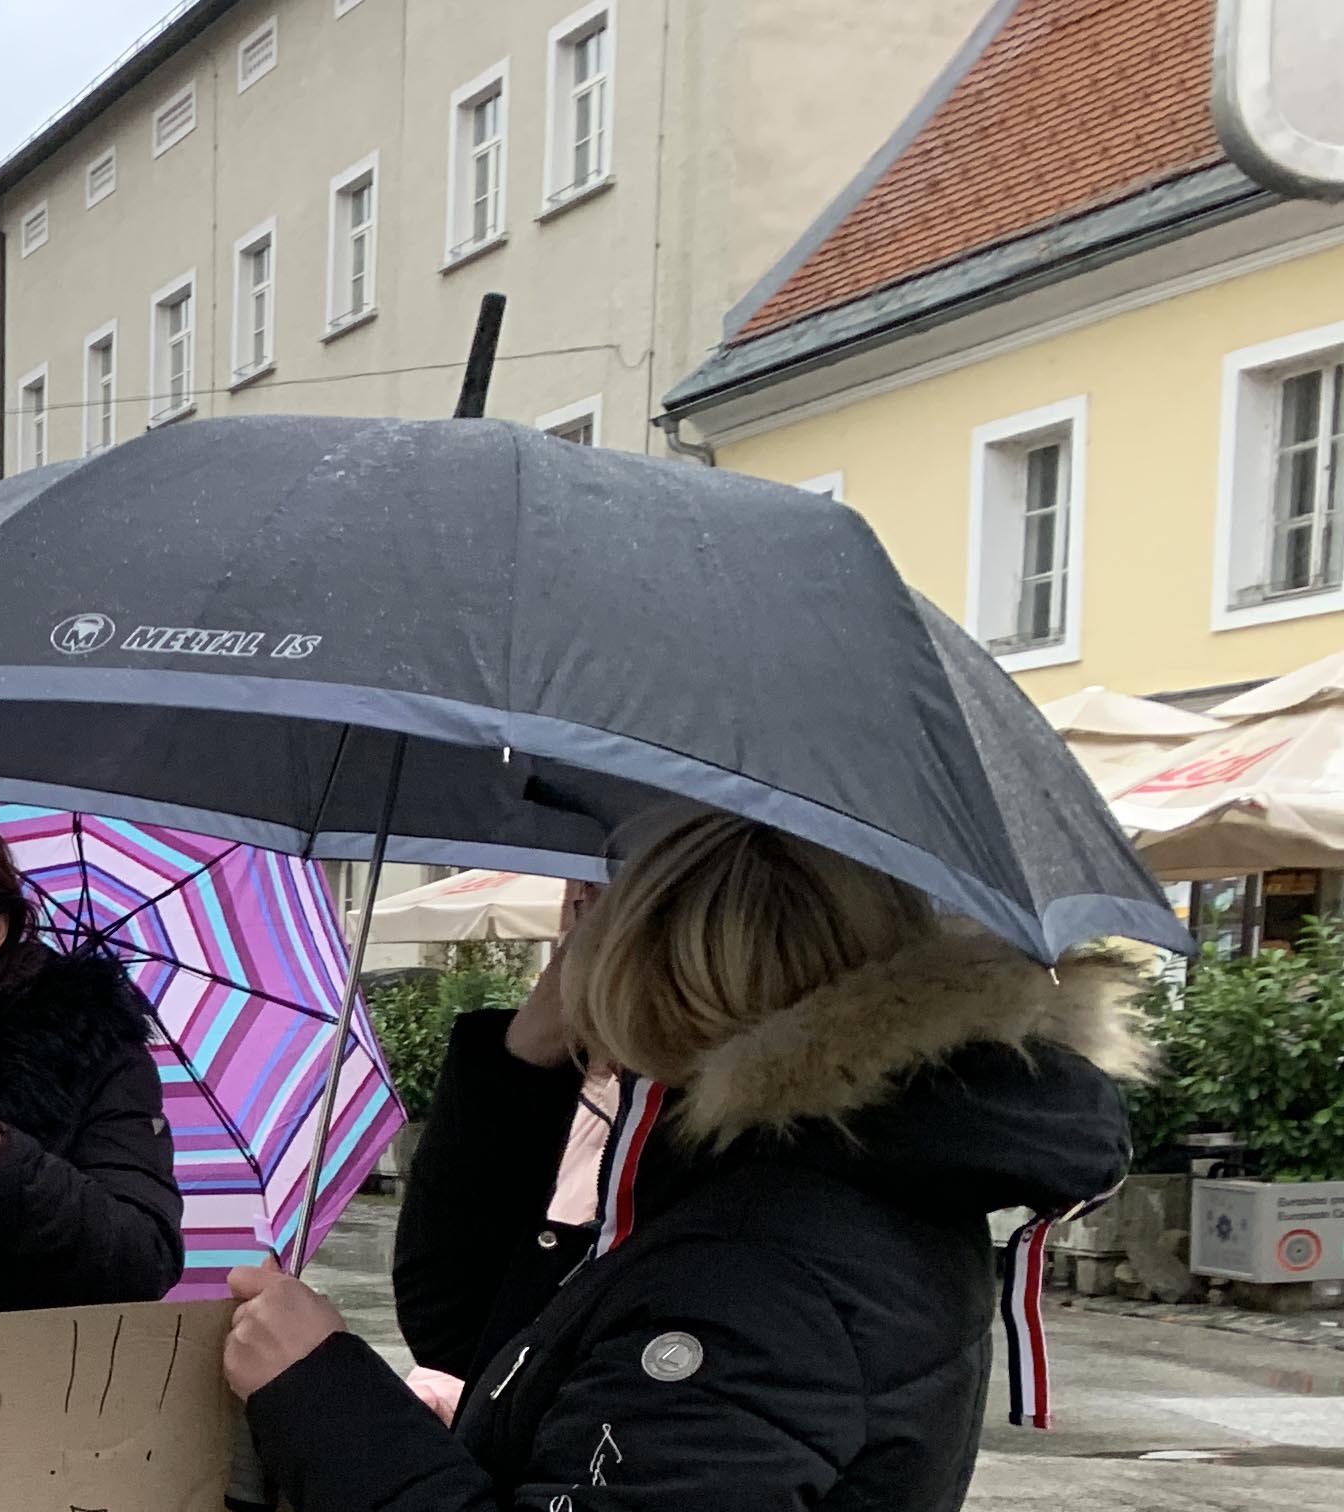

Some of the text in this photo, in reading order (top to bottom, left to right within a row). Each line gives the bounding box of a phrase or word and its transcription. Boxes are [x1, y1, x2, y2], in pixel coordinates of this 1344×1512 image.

[120, 625, 323, 659] MELTAL IS
[49, 1313, 182, 1477] !!!
